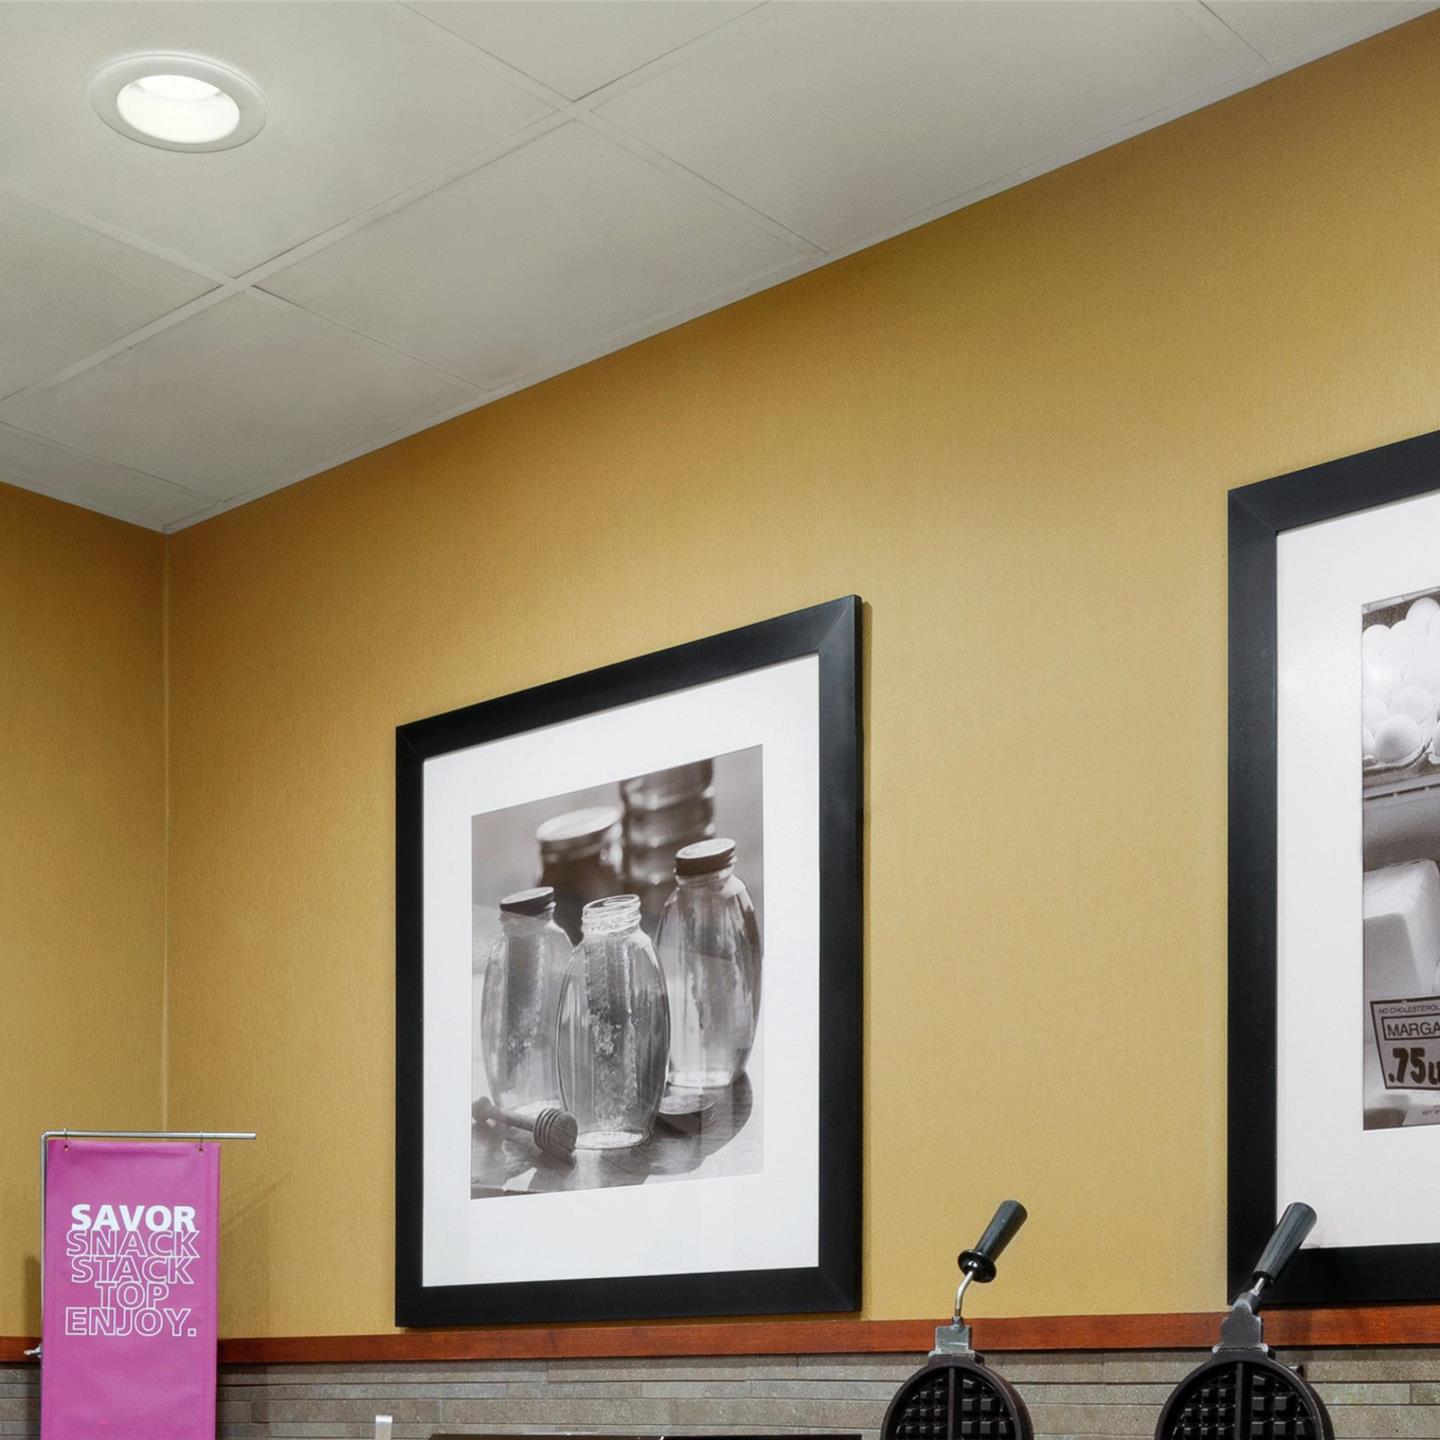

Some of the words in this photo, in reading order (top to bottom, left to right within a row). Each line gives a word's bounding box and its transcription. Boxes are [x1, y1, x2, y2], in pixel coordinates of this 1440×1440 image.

[70, 1204, 196, 1232] SAVOR
[66, 1229, 200, 1258] SNACK
[71, 1255, 194, 1284] STACK
[95, 1281, 169, 1310] TOP
[65, 1307, 197, 1337] ENJOY.
